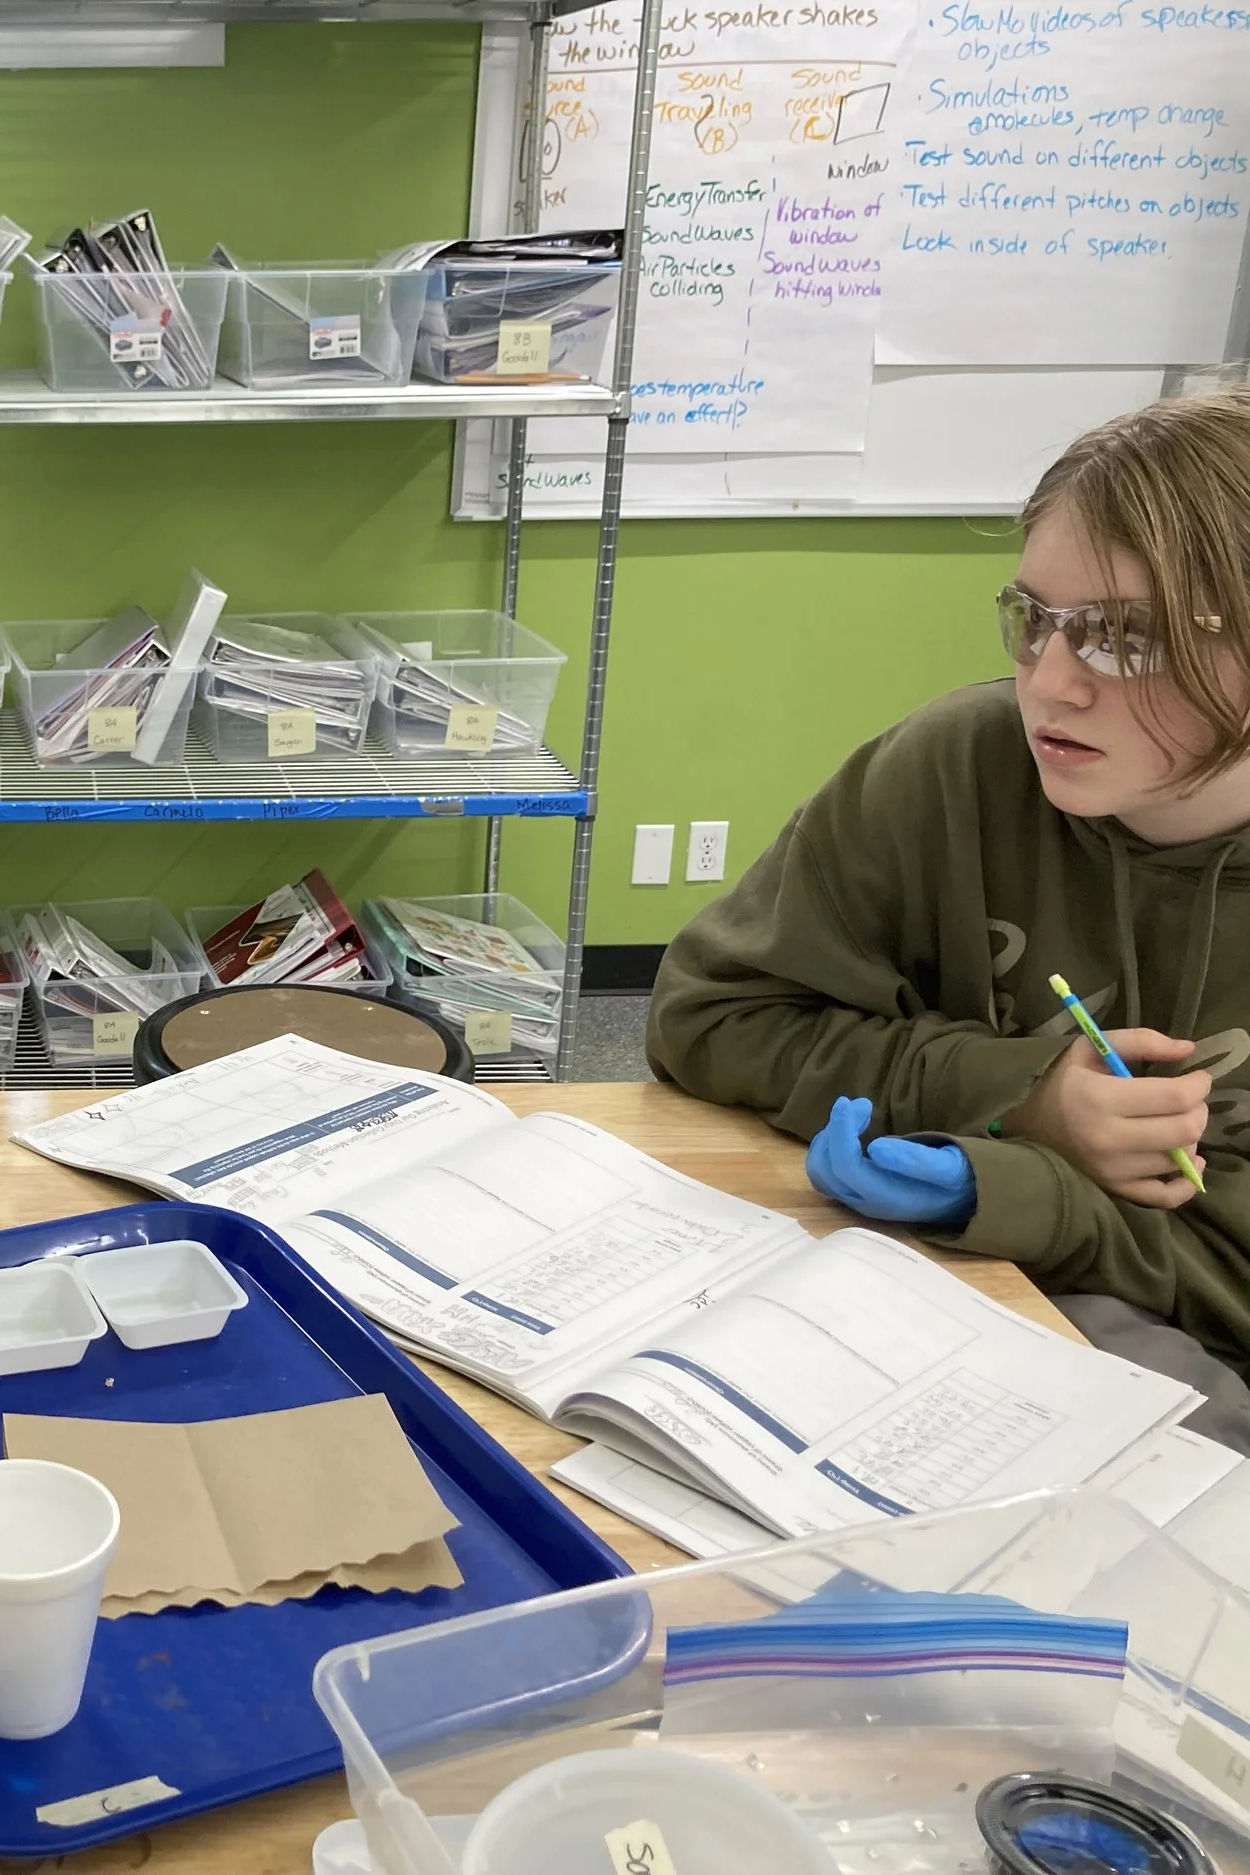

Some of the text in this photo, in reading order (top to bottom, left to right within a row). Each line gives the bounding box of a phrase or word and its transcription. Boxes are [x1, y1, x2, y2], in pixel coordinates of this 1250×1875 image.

[585, 8, 623, 36] the
[704, 4, 793, 36] speaker
[798, 5, 878, 28] shakes
[559, 40, 695, 67] the winow
[957, 37, 1050, 72] objects
[678, 69, 744, 93] Sound
[790, 61, 862, 89] Sound
[926, 78, 1070, 113] Simulations
[905, 139, 1248, 180] Test sound on different objects
[776, 192, 885, 222] Vibration of
[903, 181, 1240, 222] Test different pitches on objects
[789, 226, 859, 245] window
[969, 230, 1028, 256] inside
[1044, 229, 1076, 255] of
[663, 368, 765, 402] temperature
[628, 409, 649, 426] ave
[657, 411, 676, 425] an
